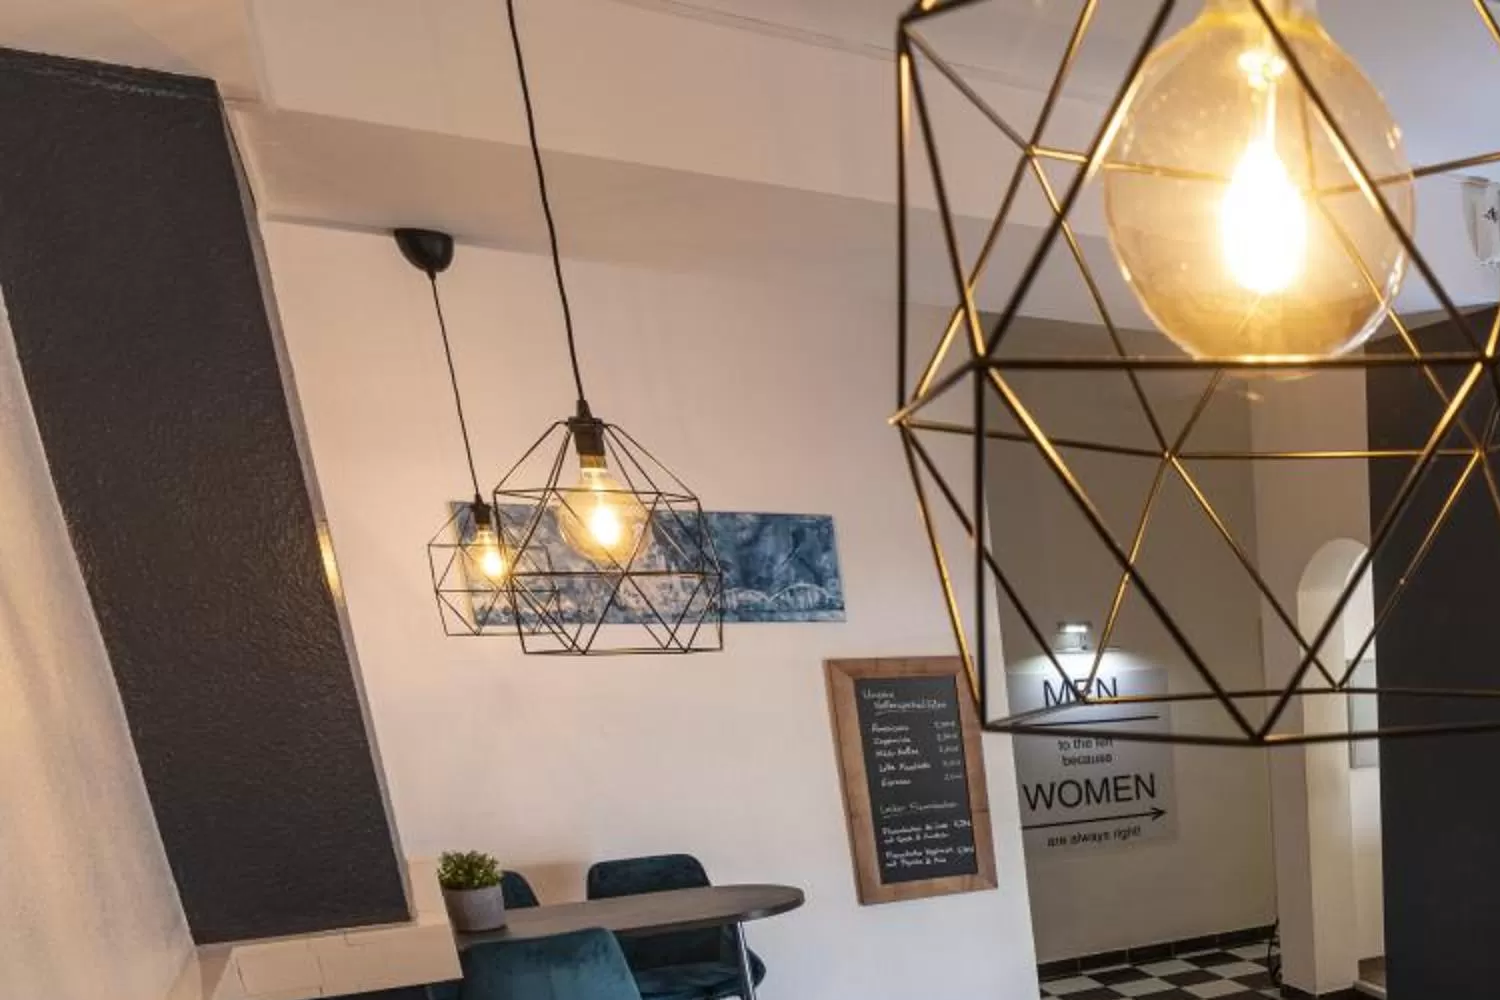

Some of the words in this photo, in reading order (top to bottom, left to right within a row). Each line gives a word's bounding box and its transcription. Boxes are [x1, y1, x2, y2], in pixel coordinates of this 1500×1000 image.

[1062, 753, 1113, 766] because
[1021, 772, 1157, 812] WOMEN
[1048, 836, 1067, 847] are
[1070, 831, 1110, 845] always
